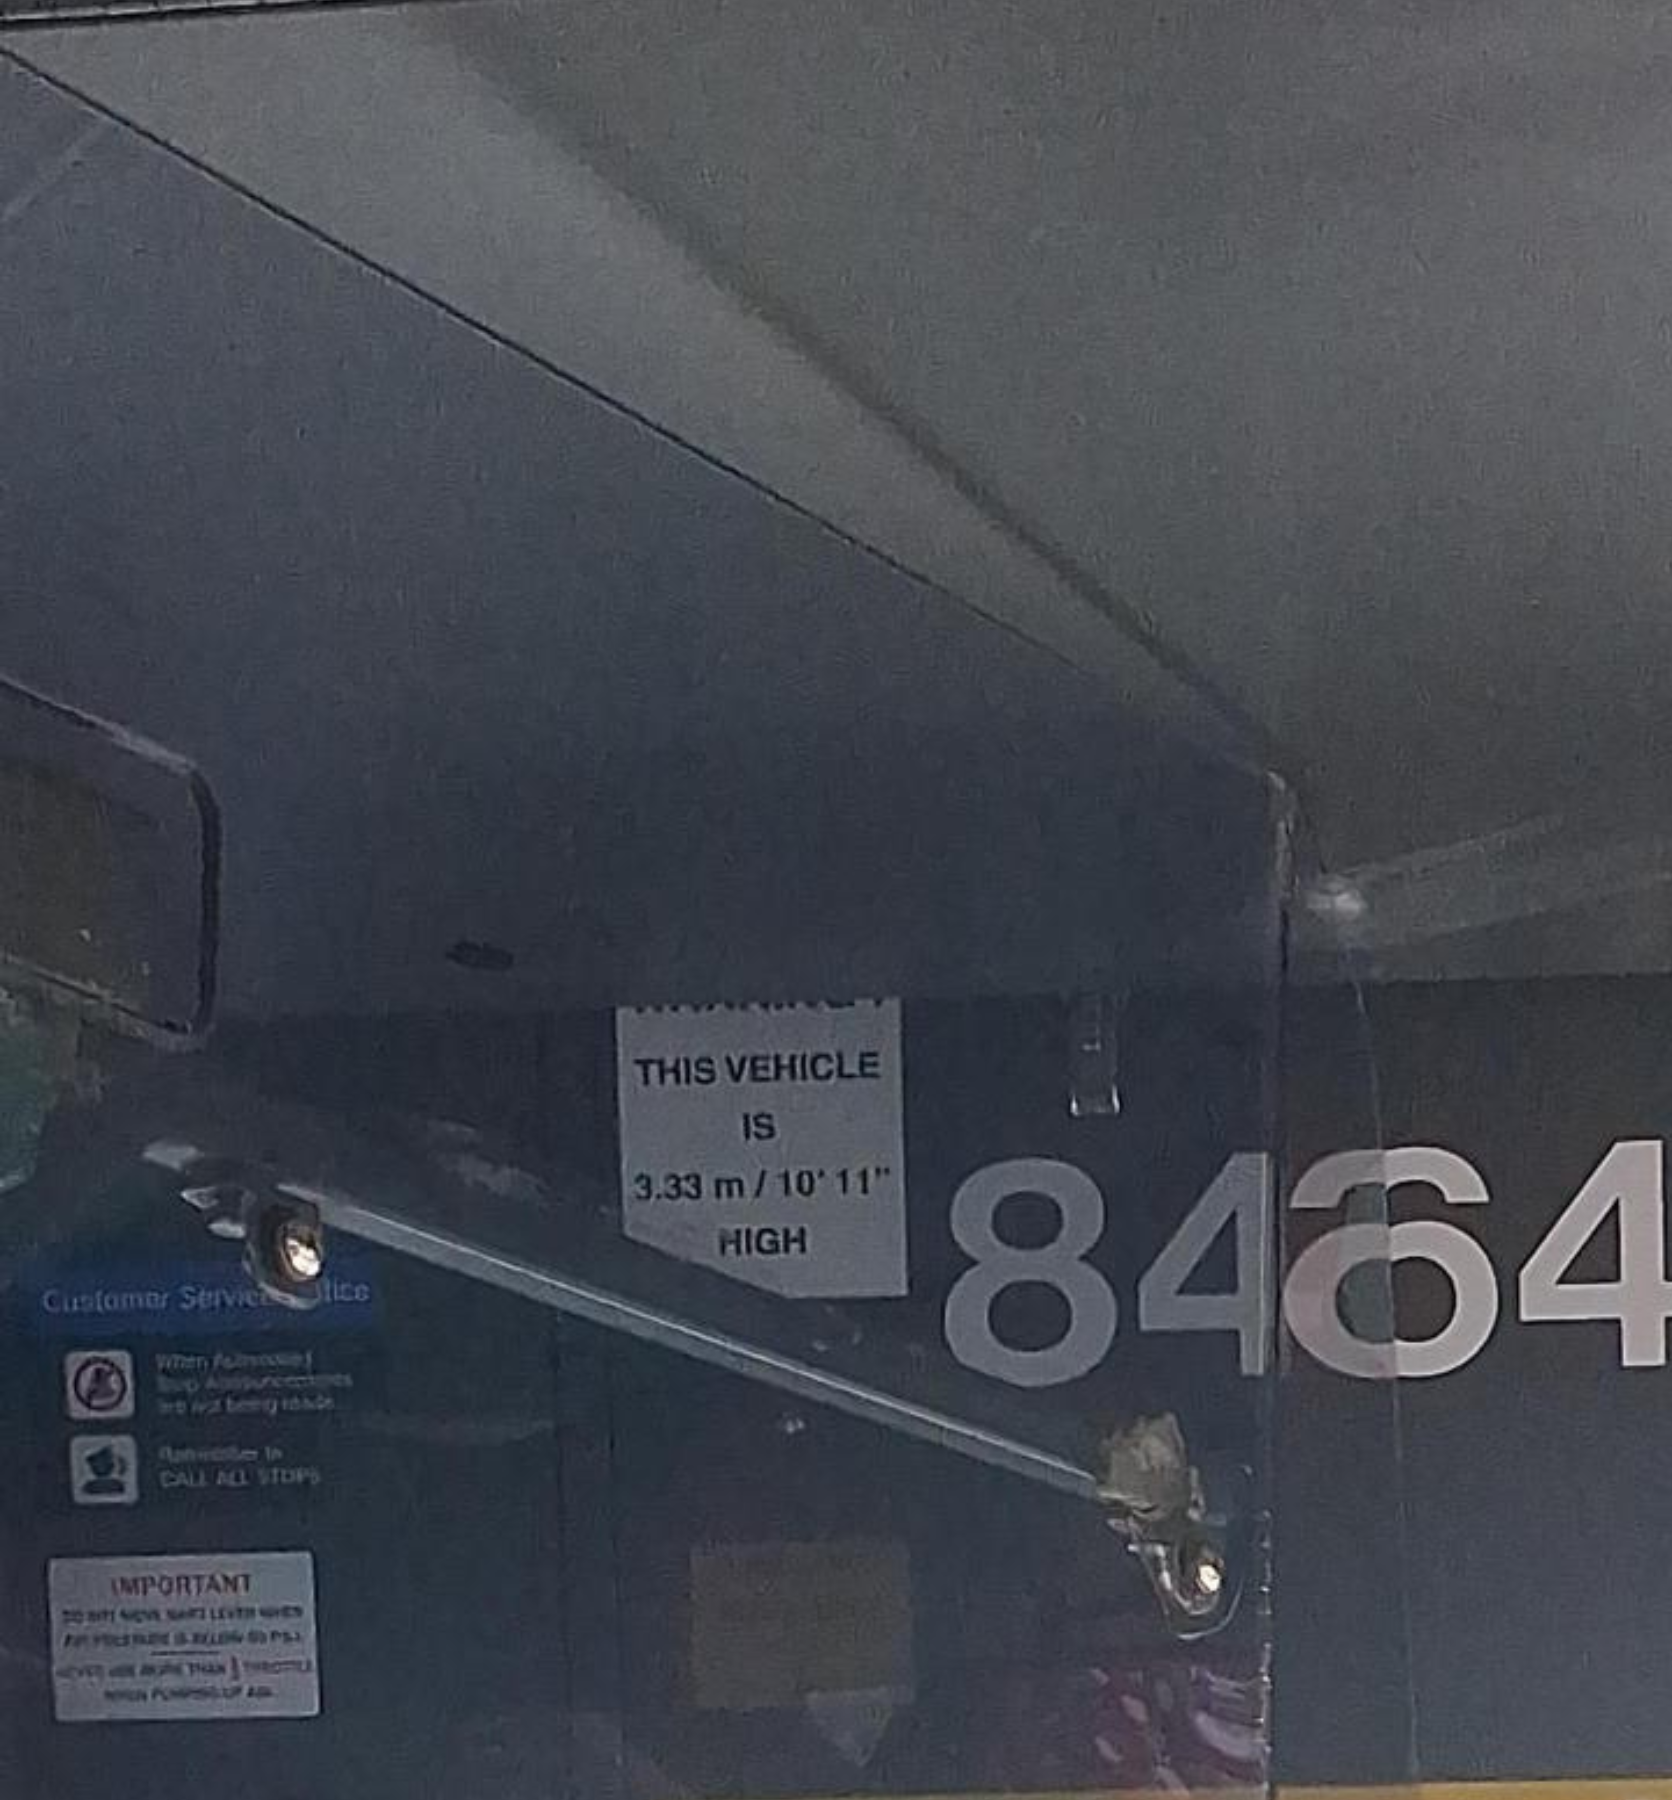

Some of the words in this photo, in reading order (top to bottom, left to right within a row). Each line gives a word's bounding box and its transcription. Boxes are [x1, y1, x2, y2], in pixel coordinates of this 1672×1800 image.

[635, 1055, 716, 1086] THIS
[725, 1051, 882, 1083] VEHICLE
[743, 1112, 776, 1141] IS
[635, 1172, 702, 1200] 3.33
[715, 1175, 744, 1198] m
[719, 1227, 807, 1256] HIGH
[43, 1287, 169, 1314] Customer
[160, 1470, 208, 1488] CALL
[215, 1470, 250, 1485] ALL
[111, 1573, 251, 1597] IMPORTANT
